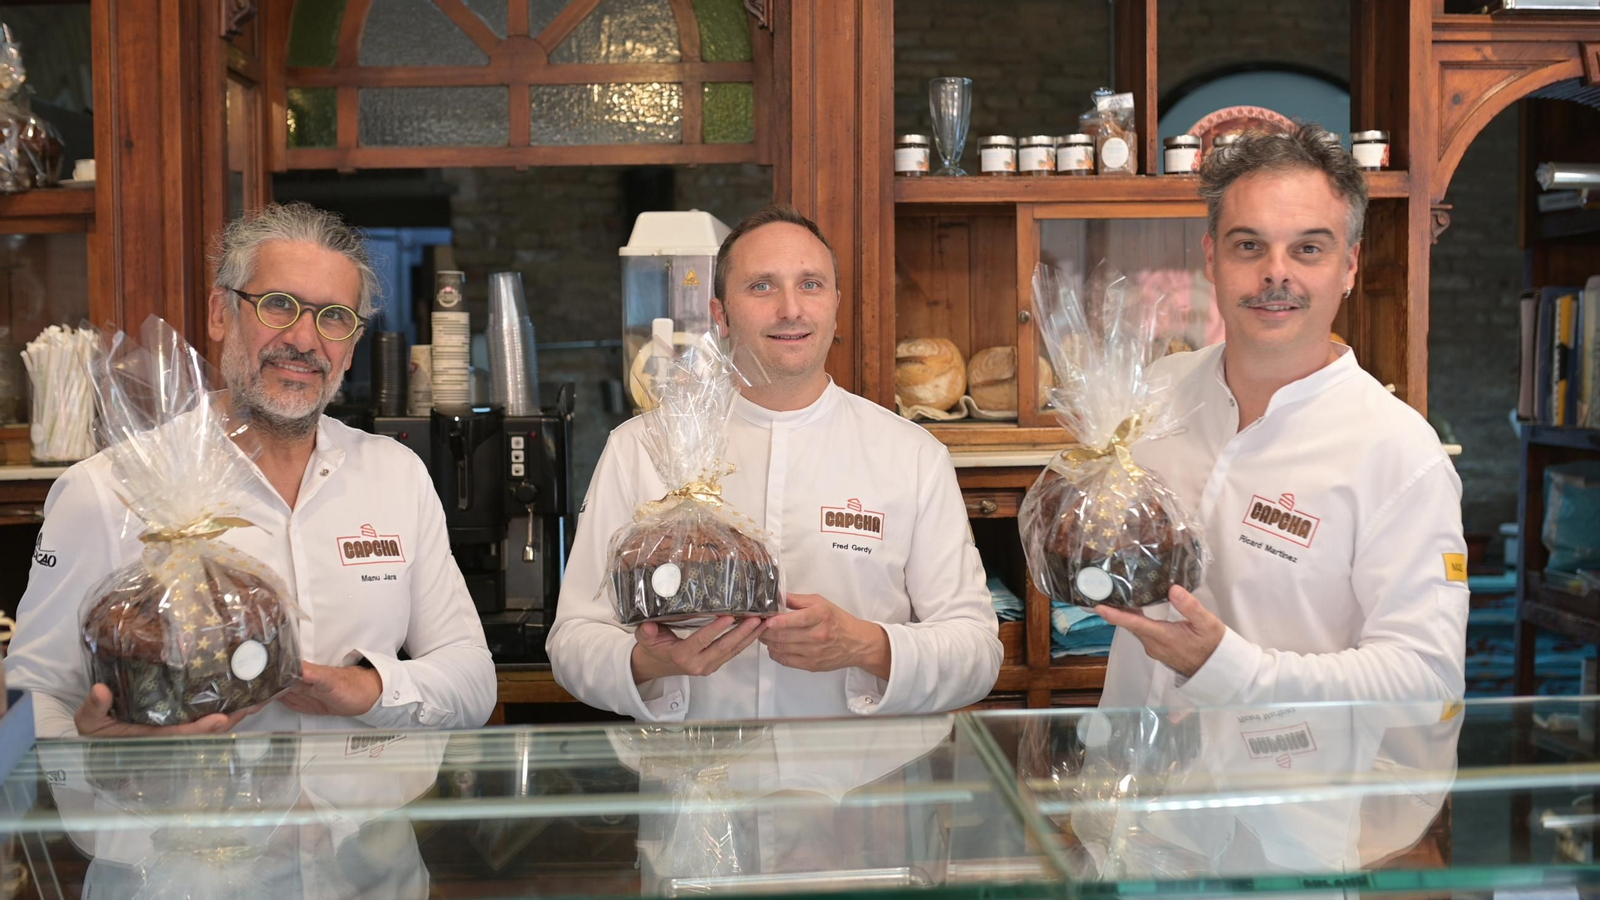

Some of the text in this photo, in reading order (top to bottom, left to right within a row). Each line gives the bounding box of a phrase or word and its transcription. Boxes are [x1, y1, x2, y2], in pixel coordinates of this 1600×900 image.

[825, 511, 881, 533] CAPCHA
[1250, 502, 1312, 539] CAPCHA
[343, 539, 400, 560] CAPCHA
[832, 542, 873, 555] Fred Gerdy
[1238, 534, 1299, 563] Ricard Martinez
[361, 573, 397, 582] Manu Jara
